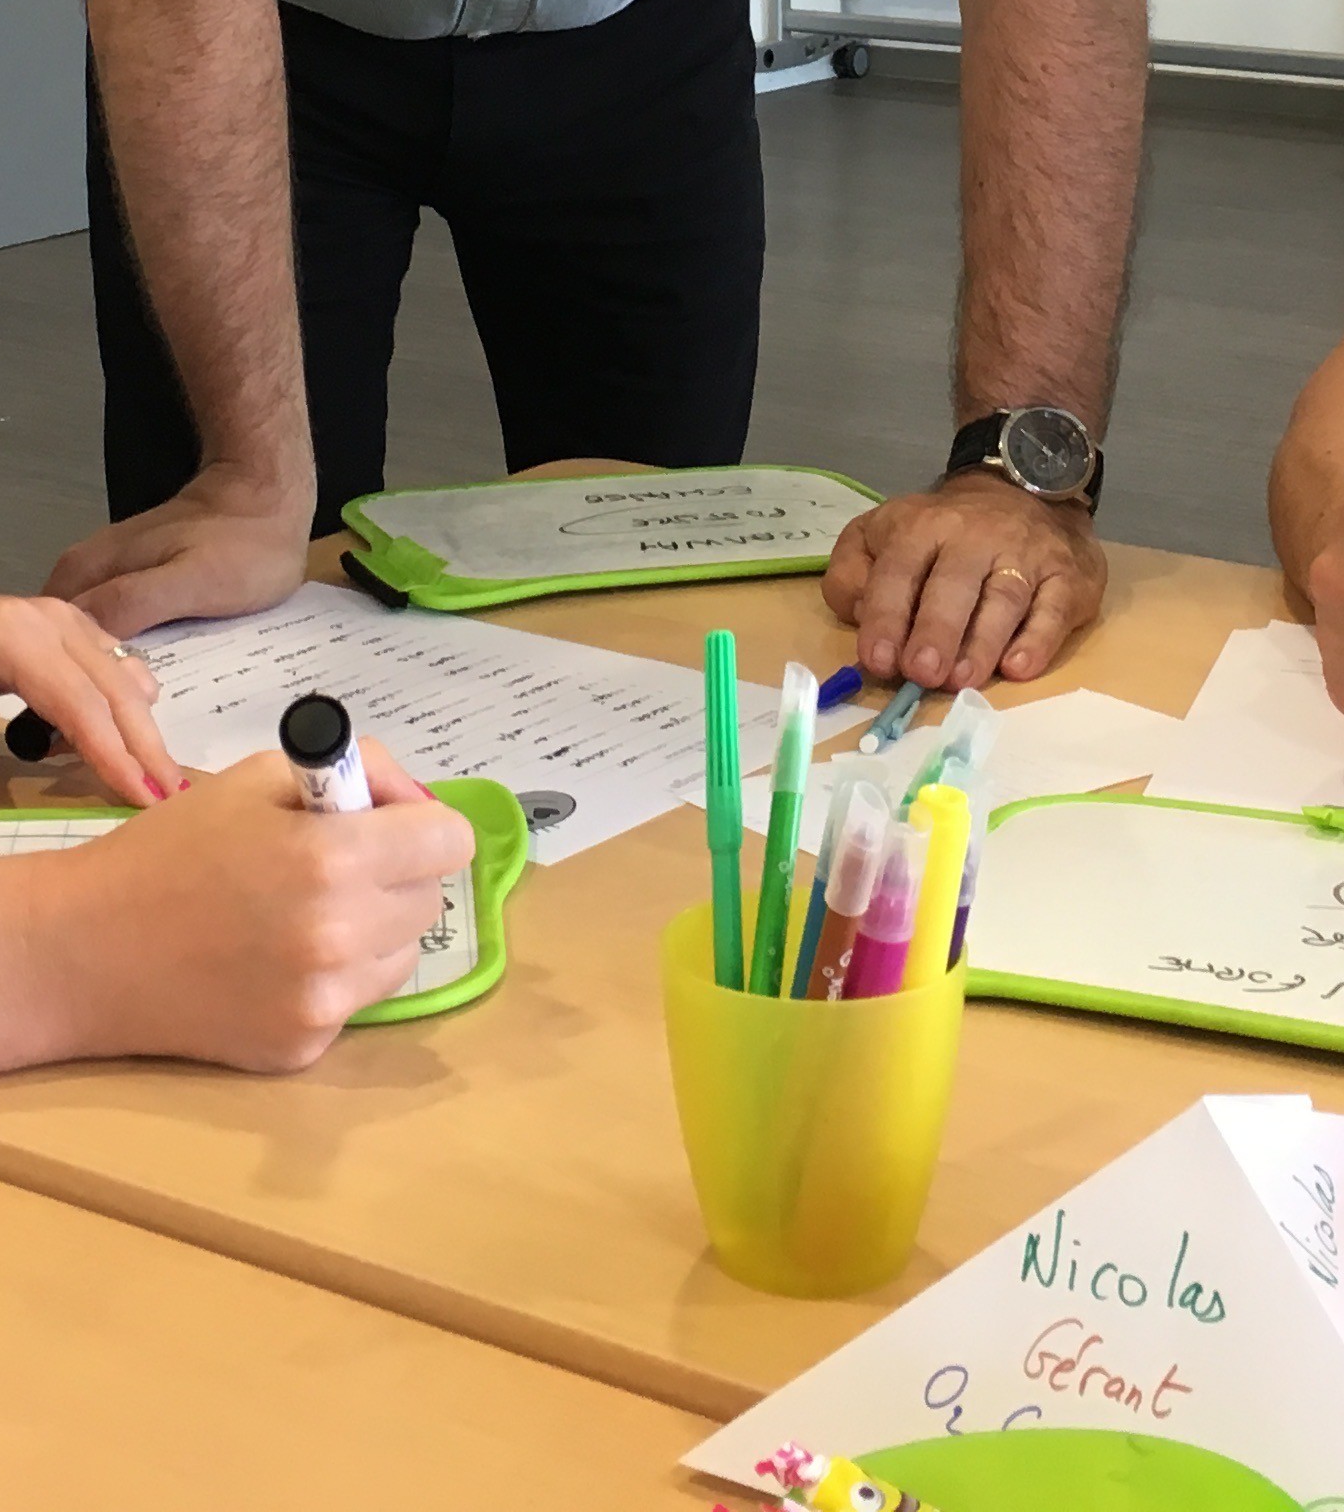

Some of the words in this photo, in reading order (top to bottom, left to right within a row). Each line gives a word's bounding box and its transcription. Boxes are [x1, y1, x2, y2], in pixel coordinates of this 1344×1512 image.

[1019, 1207, 1227, 1324] Nicolas
[1278, 1163, 1339, 1289] Nicolas
[1022, 1317, 1193, 1421] Gérant
